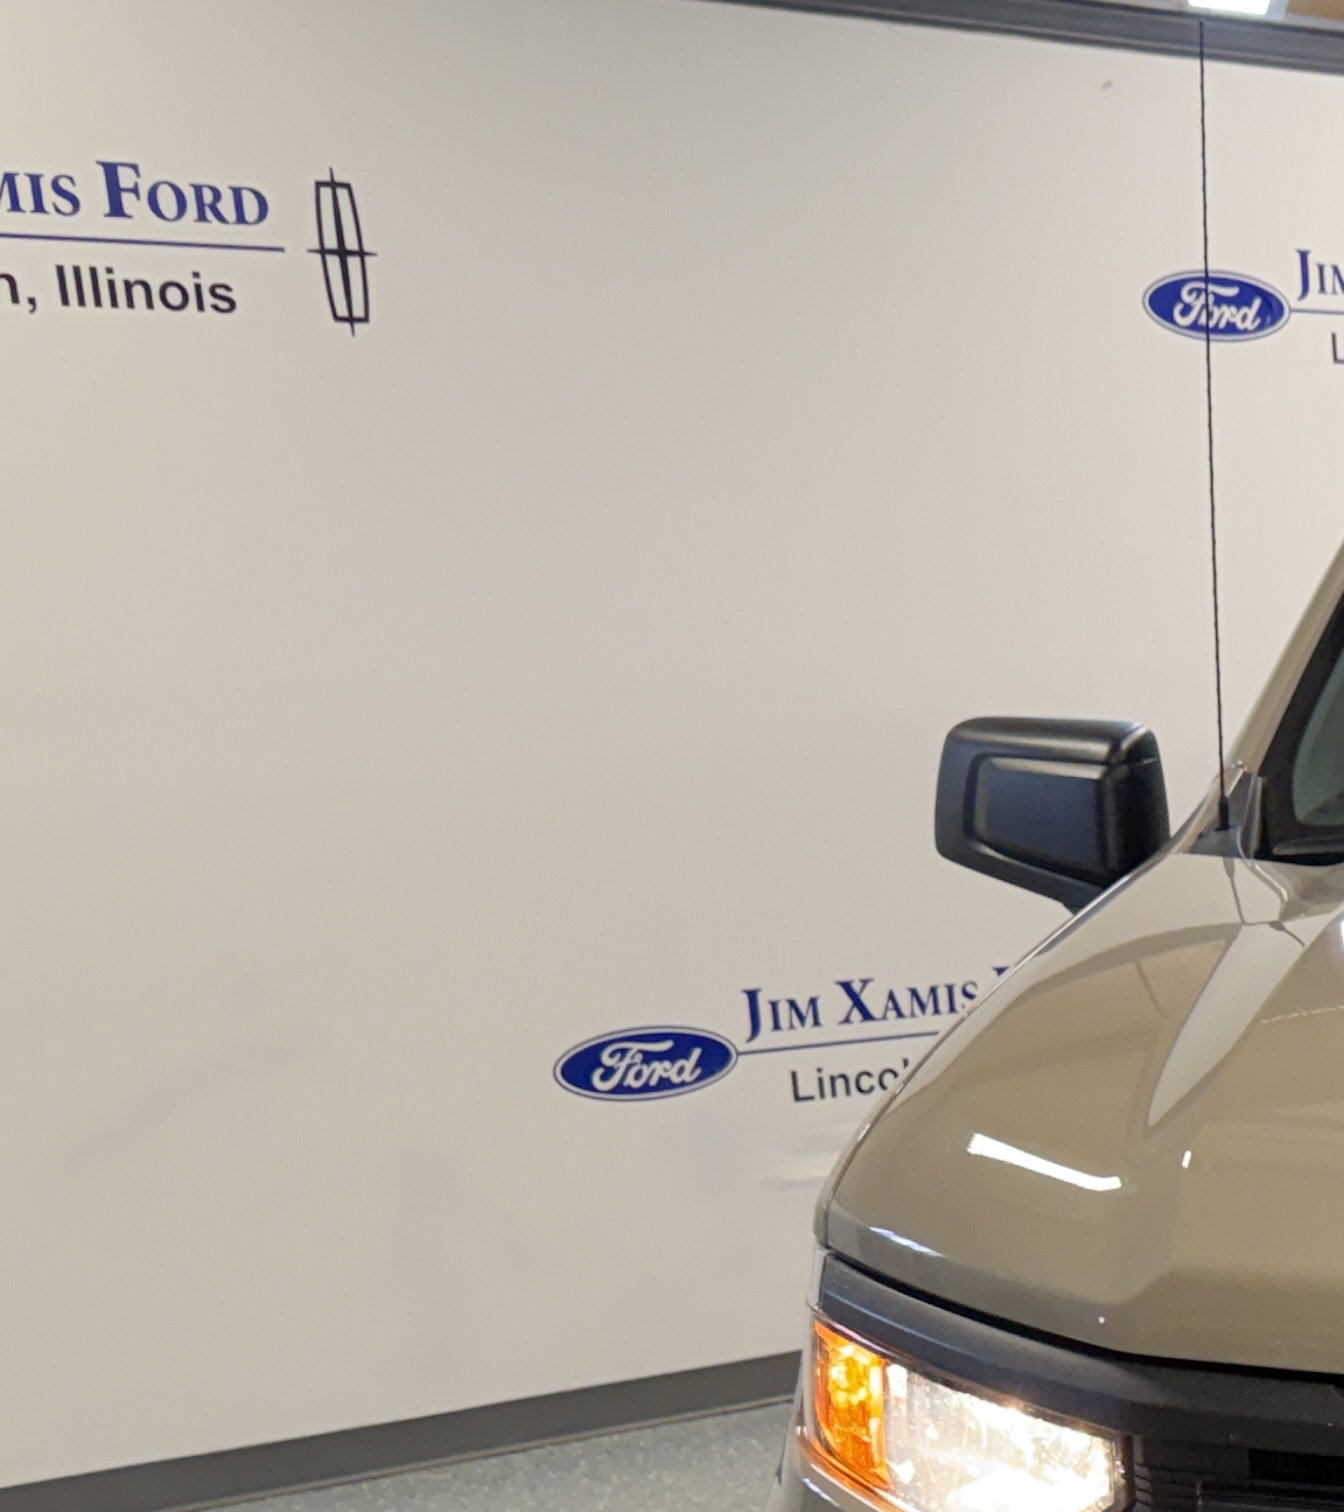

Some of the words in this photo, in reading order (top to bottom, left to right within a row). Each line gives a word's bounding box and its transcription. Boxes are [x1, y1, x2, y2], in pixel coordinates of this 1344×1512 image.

[96, 160, 269, 226] FORD
[55, 264, 237, 314] Illinois
[1173, 281, 1262, 332] Ford
[742, 988, 822, 1043] JIM
[835, 978, 979, 1025] XAMIS
[592, 1040, 702, 1090] Ford
[790, 1057, 909, 1102] Linco
